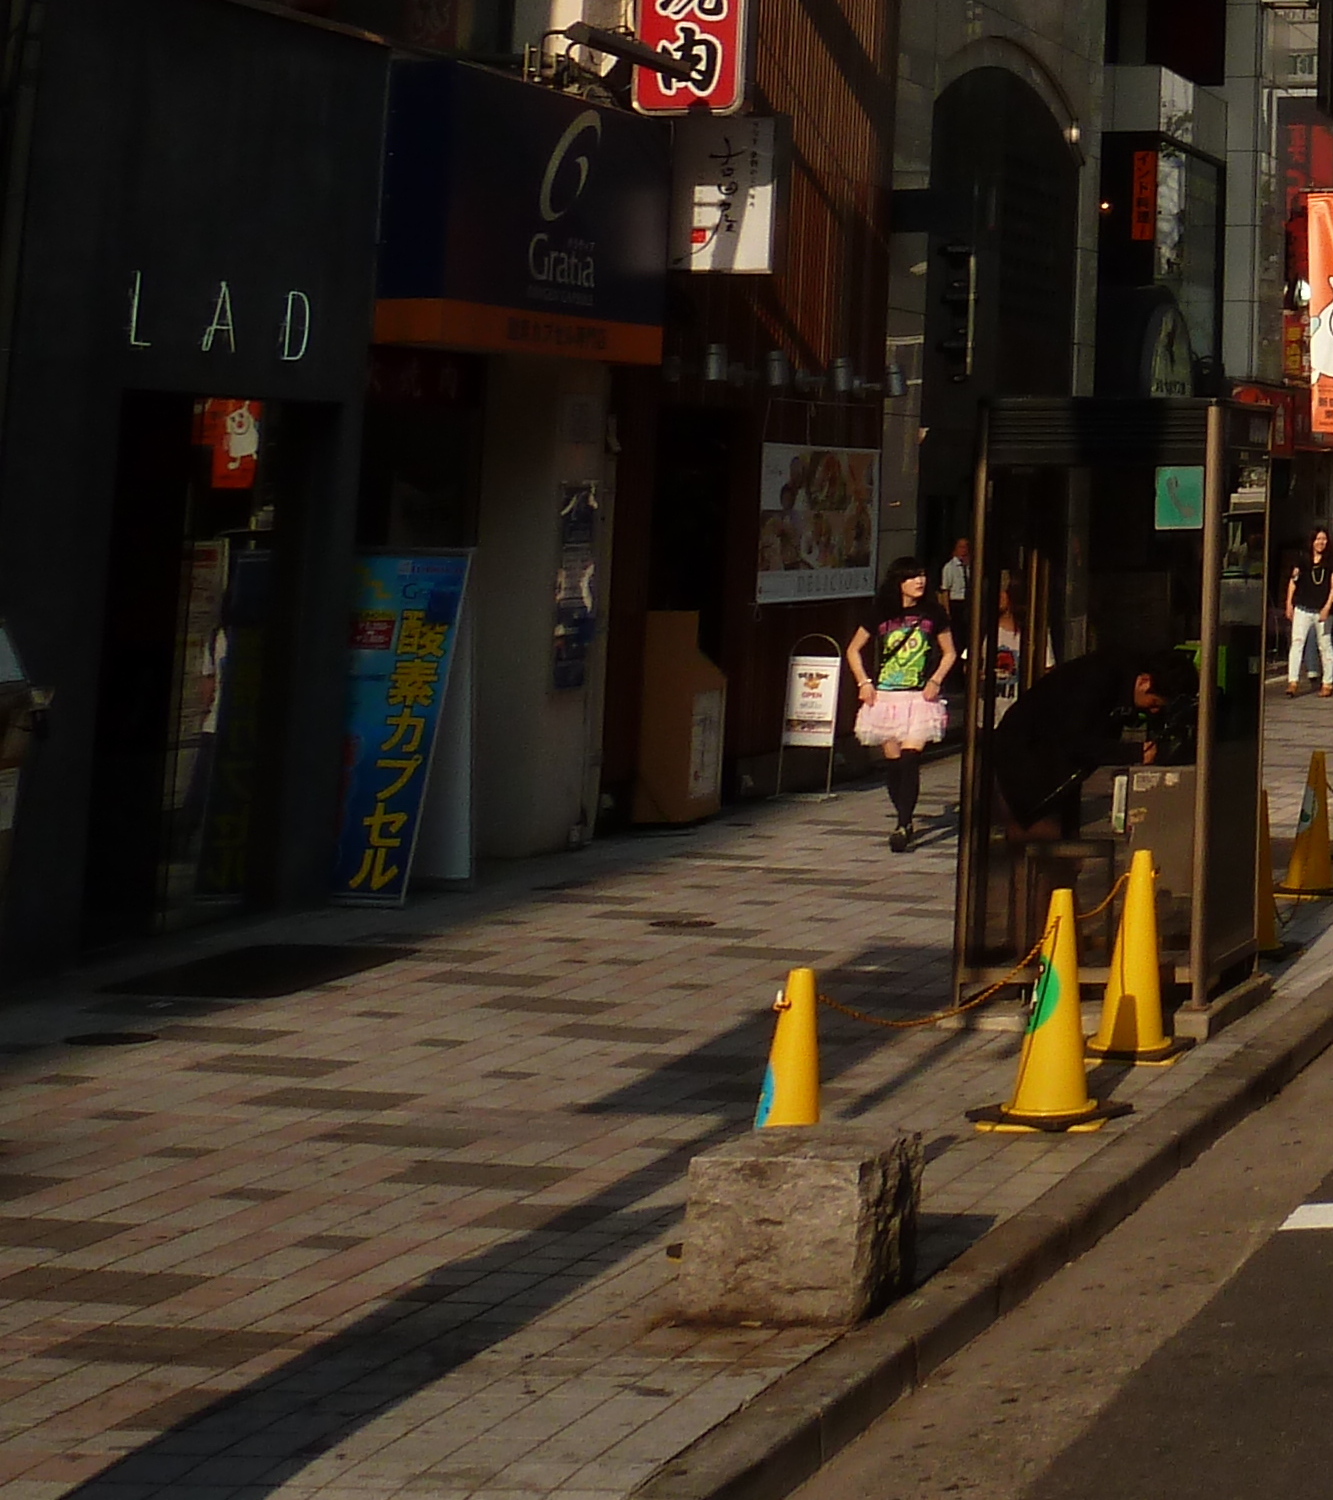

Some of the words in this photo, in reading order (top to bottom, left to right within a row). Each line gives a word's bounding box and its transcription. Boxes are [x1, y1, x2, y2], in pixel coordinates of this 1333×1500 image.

[528, 231, 596, 289] Gratia
[348, 607, 450, 892] 酸素カプセル
